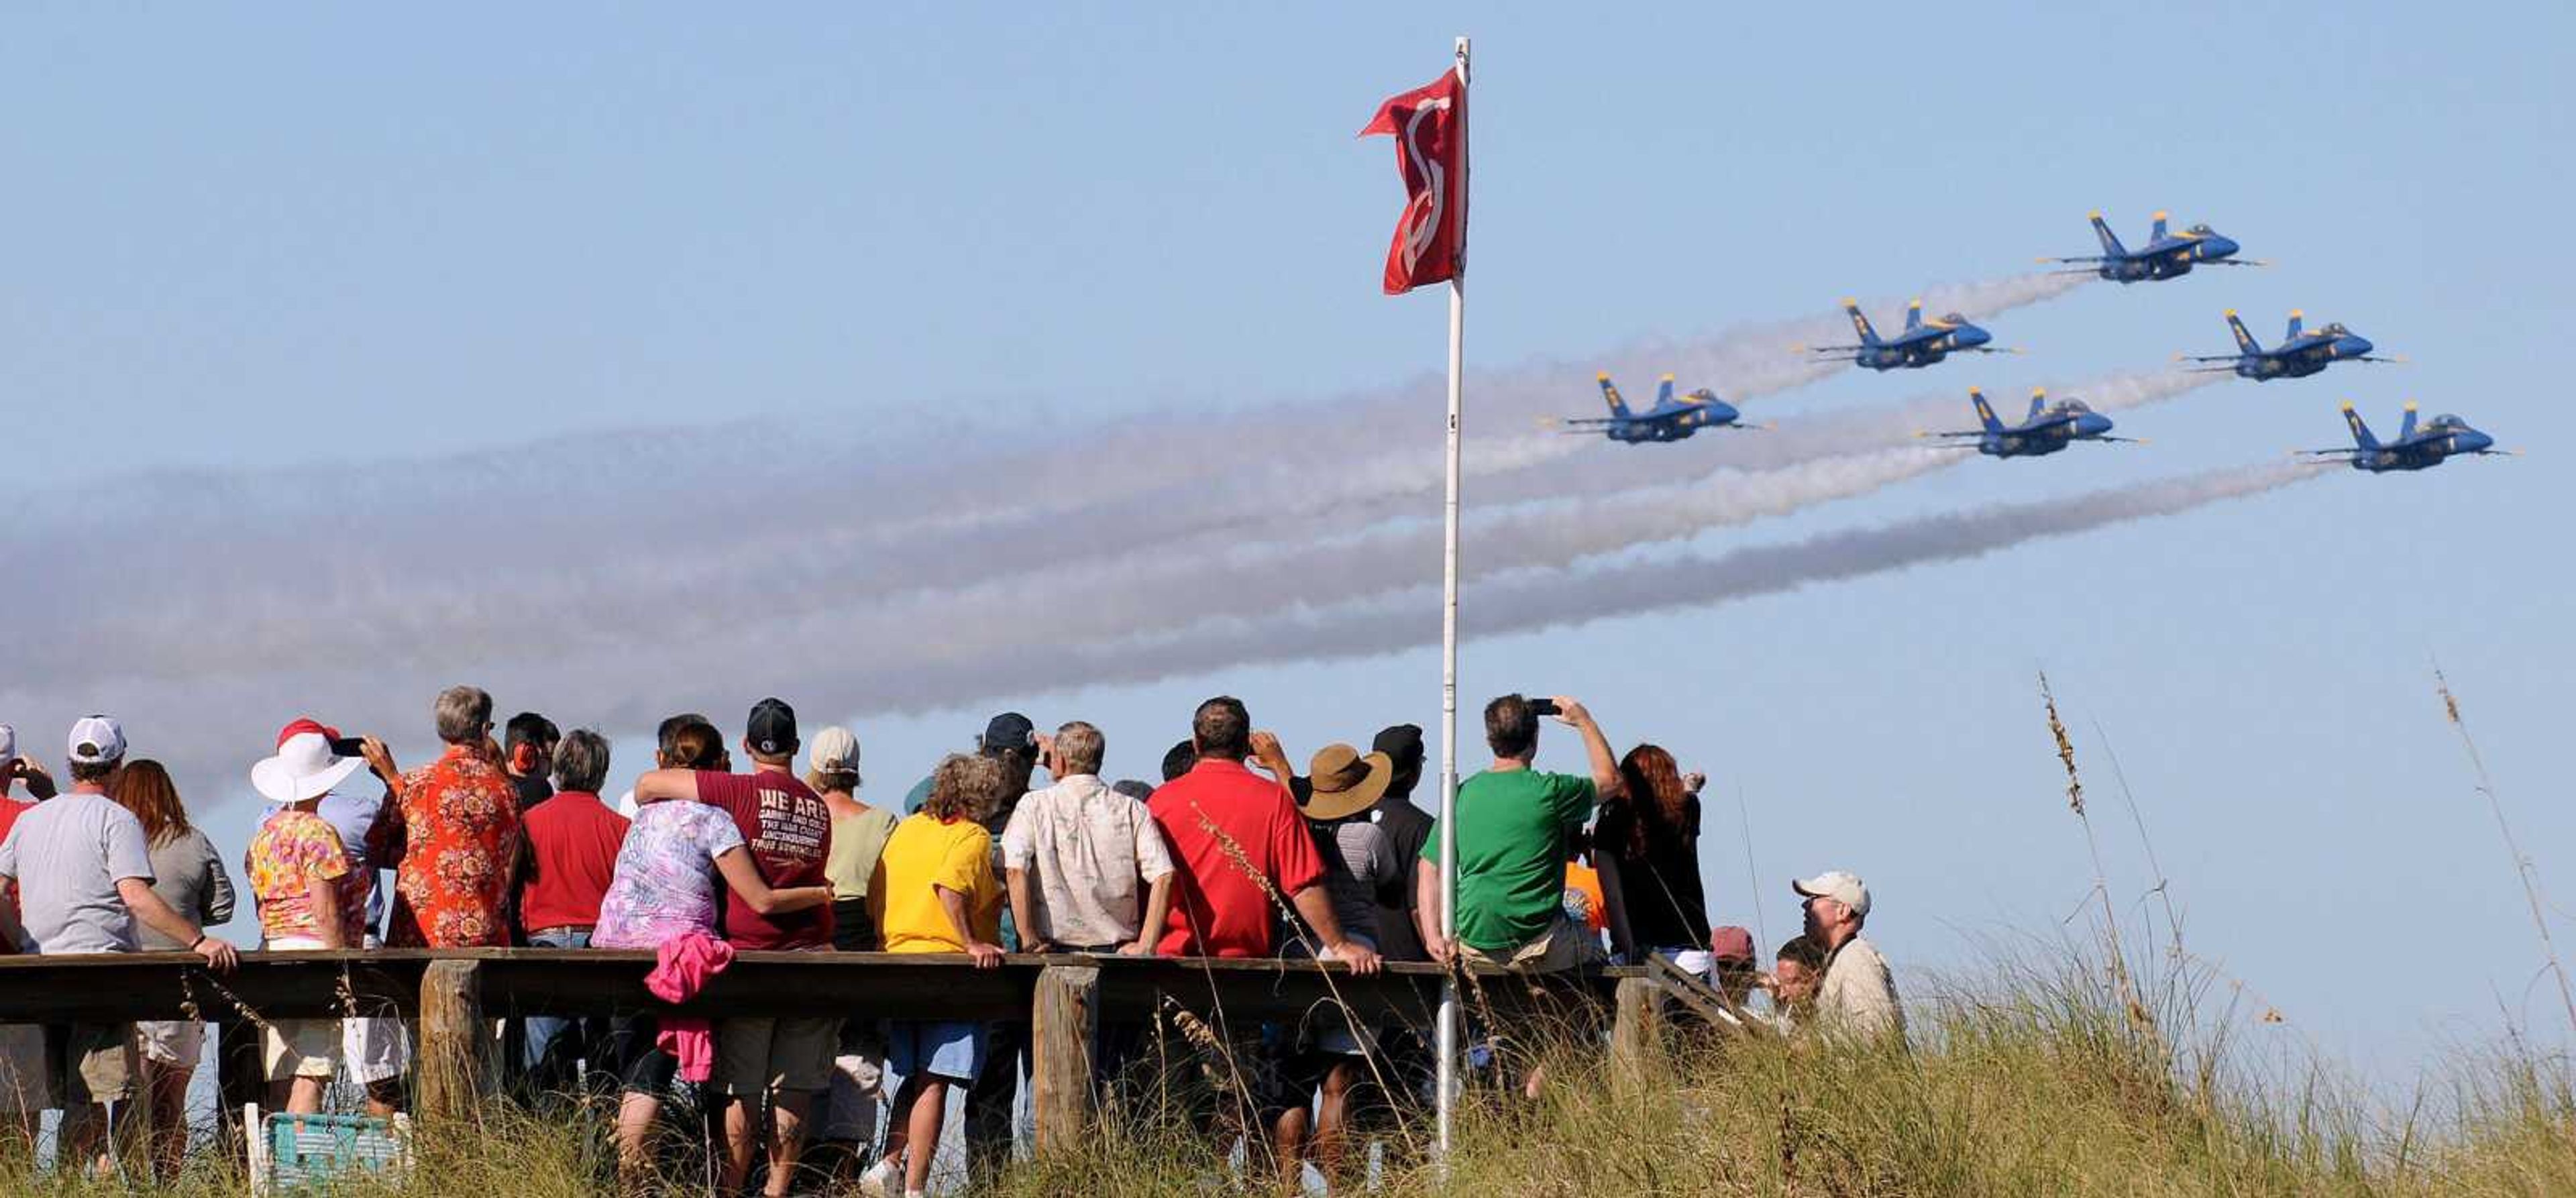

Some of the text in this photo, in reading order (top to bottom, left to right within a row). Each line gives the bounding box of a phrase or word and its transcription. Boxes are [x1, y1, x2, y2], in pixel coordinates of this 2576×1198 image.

[759, 788, 827, 820] WE ARE
[761, 820, 780, 830] THE
[792, 814, 807, 825] AND
